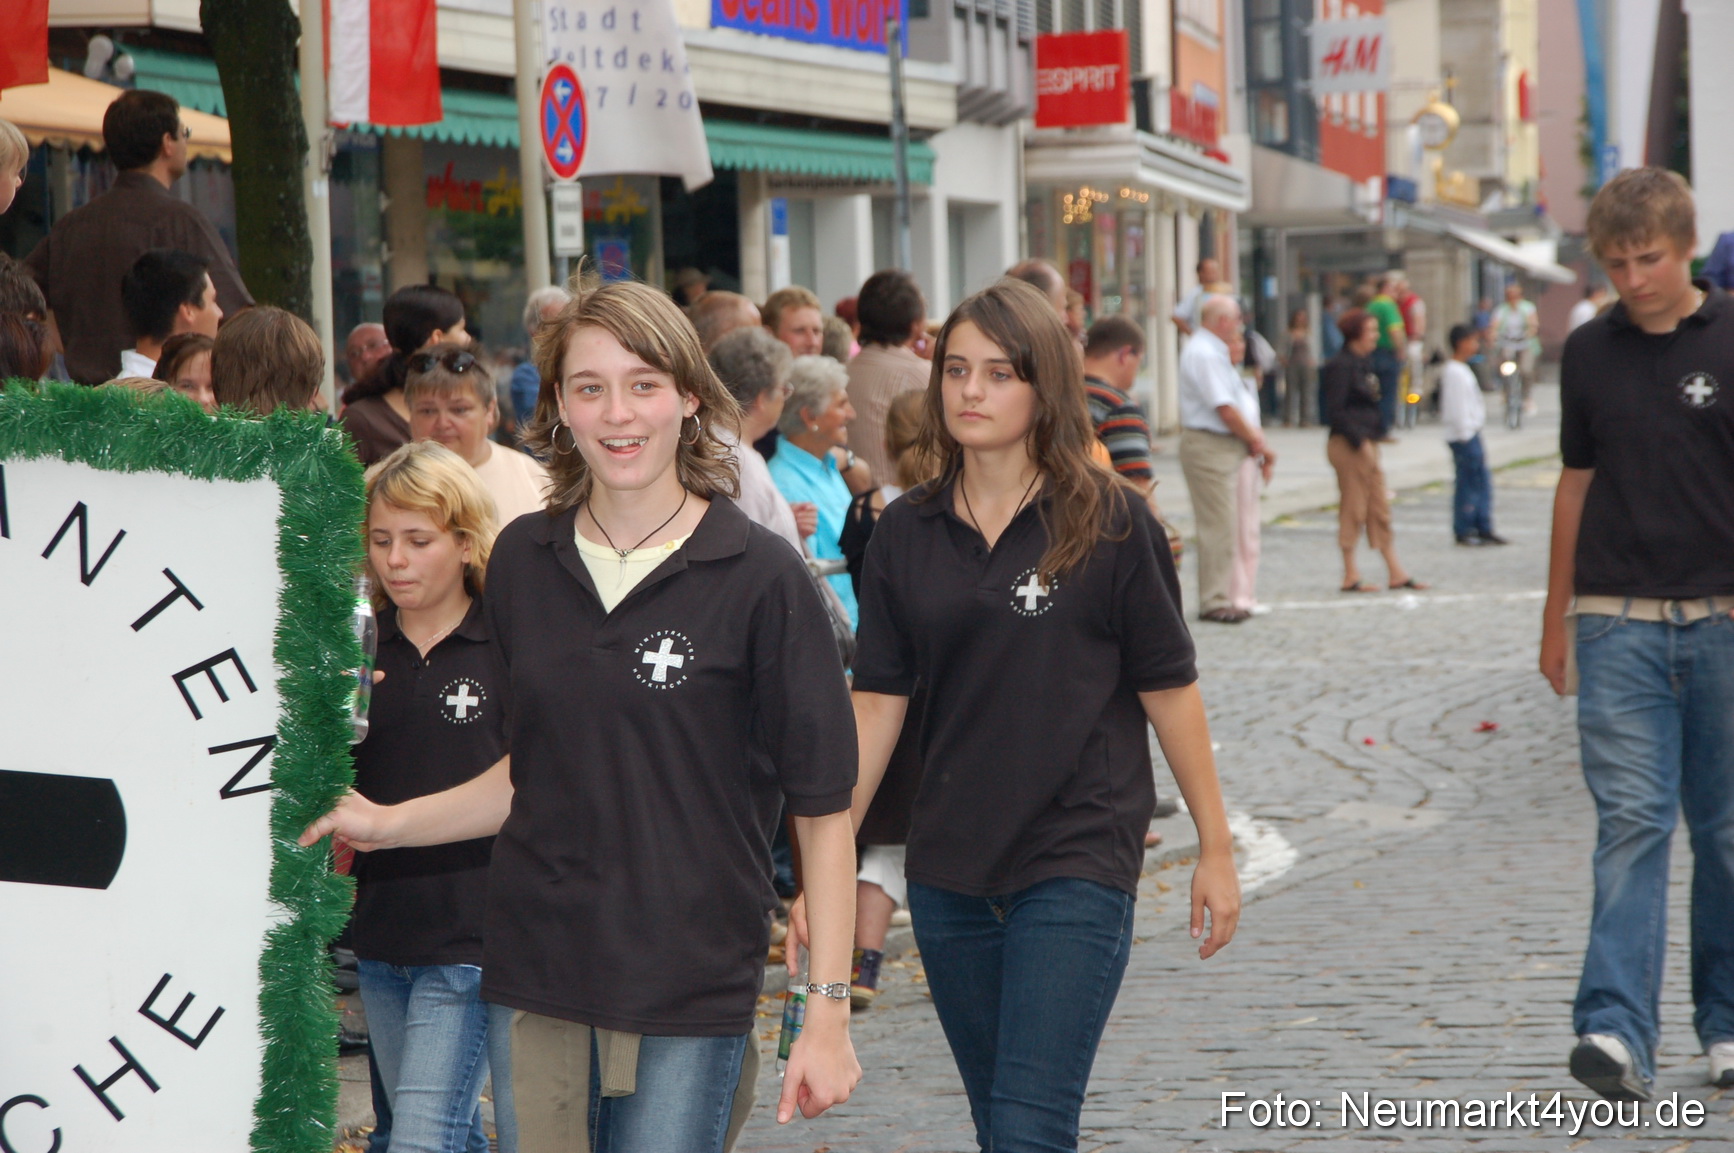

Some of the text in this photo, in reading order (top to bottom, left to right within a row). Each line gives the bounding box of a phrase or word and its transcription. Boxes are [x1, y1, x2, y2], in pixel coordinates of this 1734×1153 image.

[550, 6, 641, 32] Stadt
[1037, 63, 1120, 96] ESPRIT
[0, 463, 279, 800] NTEN
